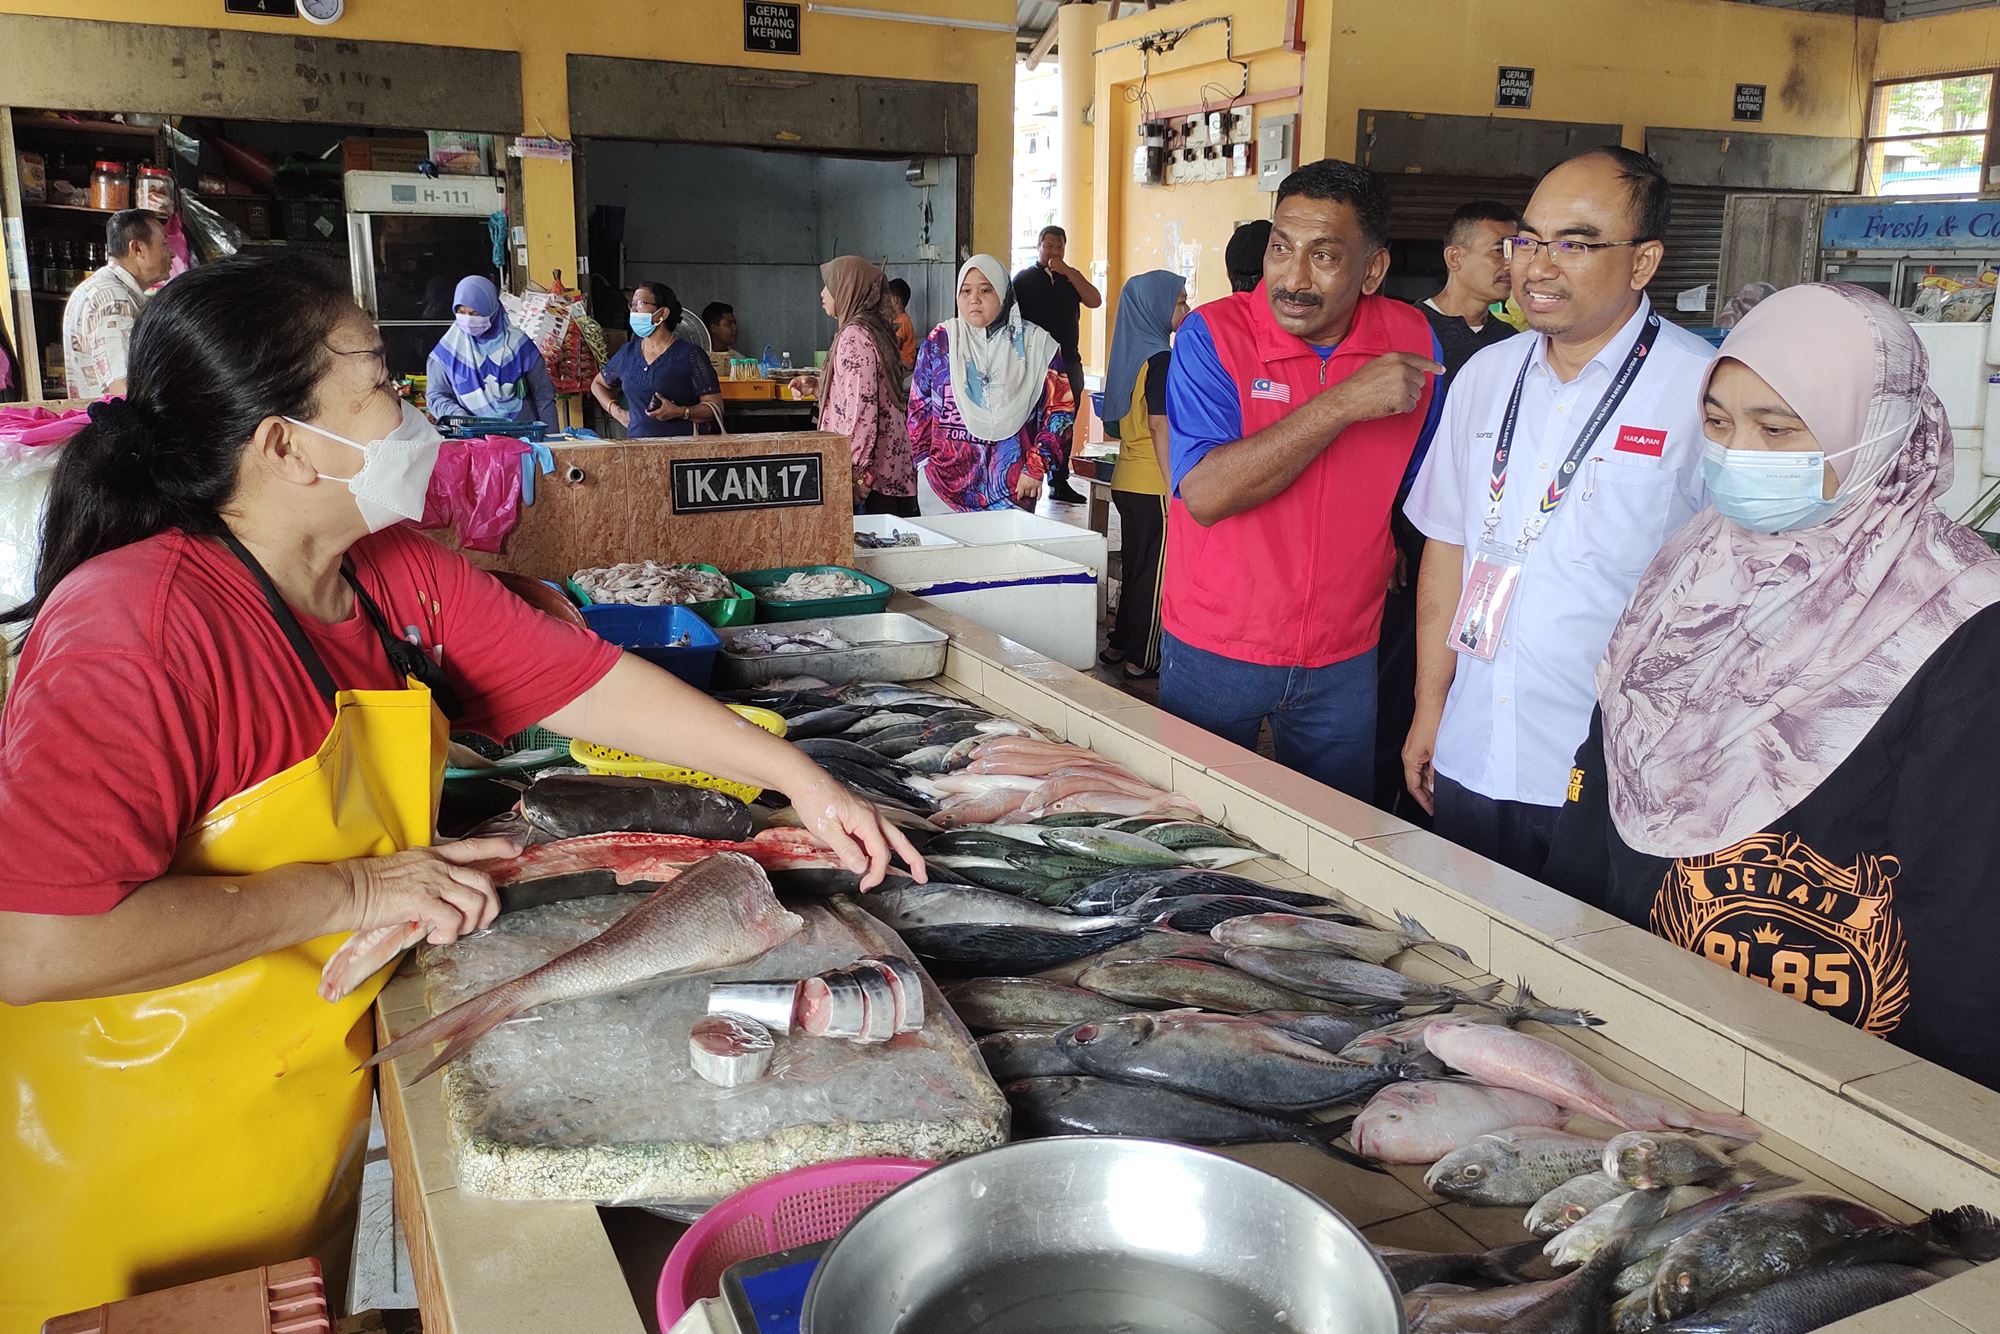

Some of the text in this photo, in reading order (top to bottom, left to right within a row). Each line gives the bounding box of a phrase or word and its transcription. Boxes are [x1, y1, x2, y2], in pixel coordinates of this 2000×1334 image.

[756, 5, 788, 17] GERAI
[750, 16, 795, 29] BARANG
[752, 27, 792, 39] KERING
[769, 39, 776, 49] 3
[1505, 71, 1527, 79] GERAI
[1500, 79, 1530, 89] BARANG
[1501, 88, 1527, 97] KERING
[1741, 87, 1760, 95] GERAI
[1511, 96, 1516, 104] 2
[1736, 95, 1763, 104] BARANG
[1737, 103, 1760, 111] KERING
[424, 189, 469, 204] H-111
[1862, 213, 1929, 239] Fresh
[1936, 215, 1959, 238] &
[1620, 356, 1639, 385] MALAYSIA
[945, 429, 966, 440] FOR
[1623, 434, 1660, 446] HARAPAN
[686, 465, 808, 503] IKAN 17
[1724, 867, 1838, 915] JENAN
